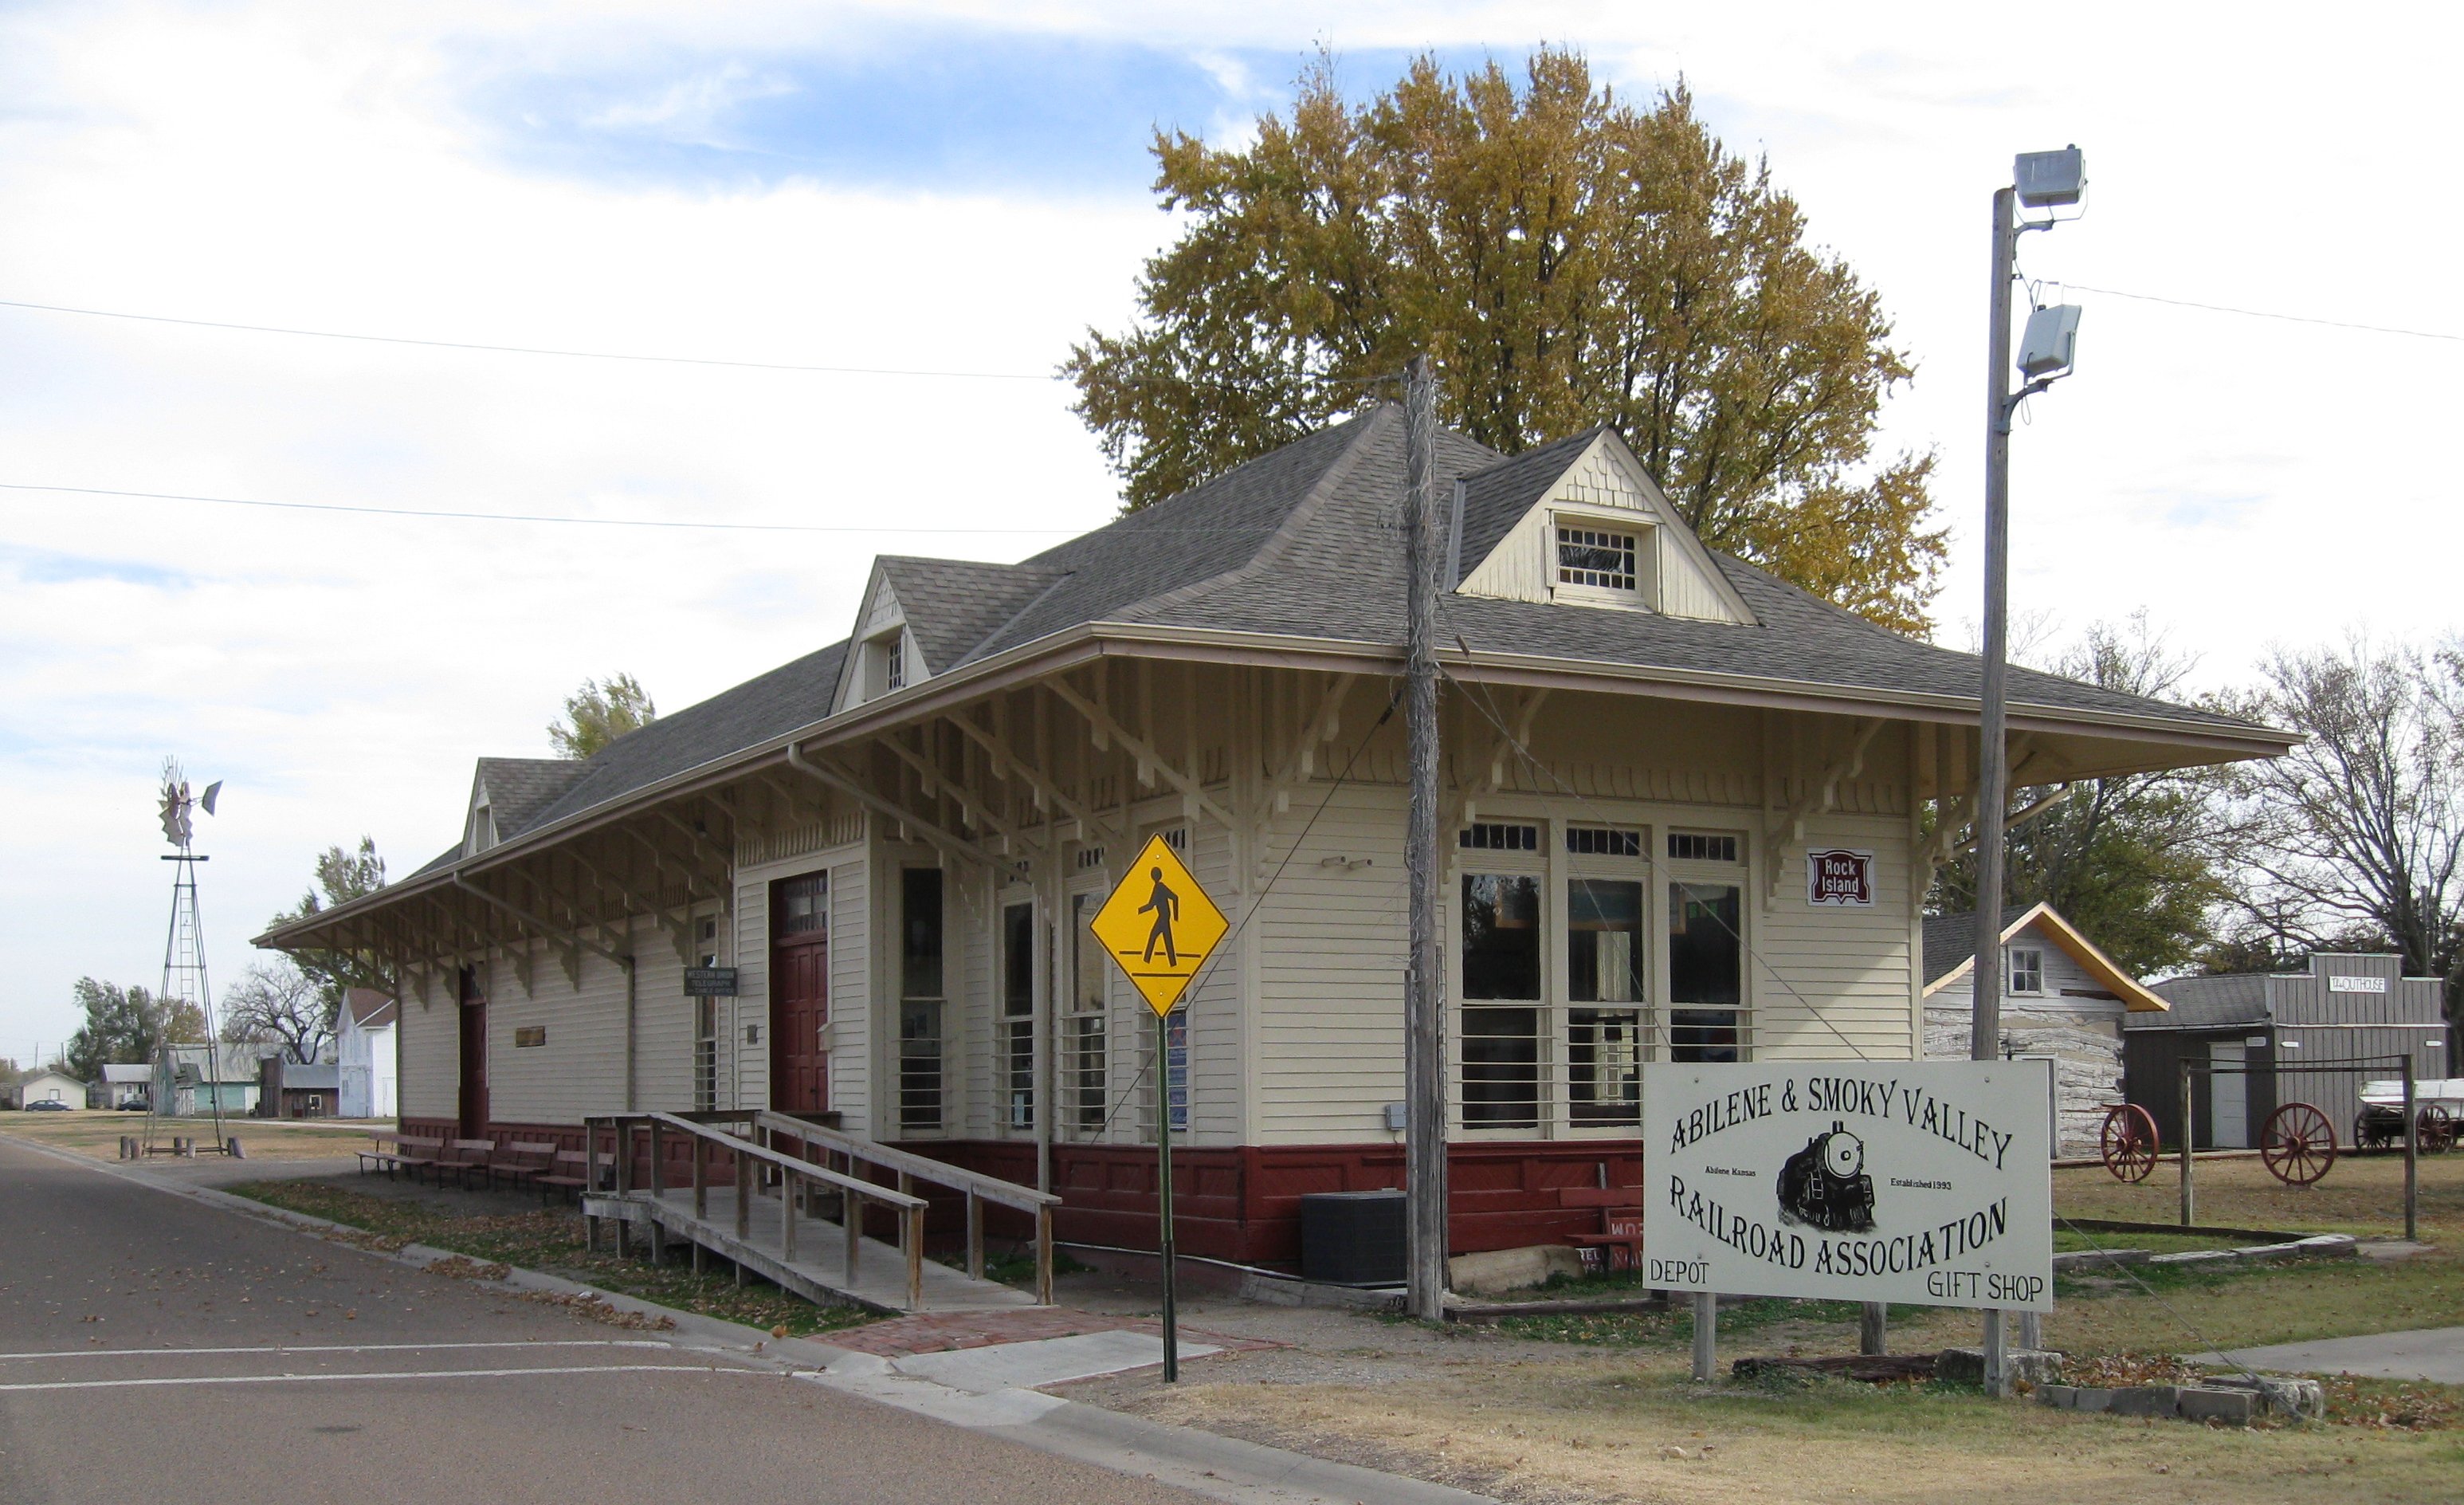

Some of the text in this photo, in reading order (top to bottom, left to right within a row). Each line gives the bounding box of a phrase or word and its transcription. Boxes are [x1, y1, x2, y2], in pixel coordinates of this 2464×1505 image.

[1825, 859, 1856, 875] Rock
[1822, 876, 1859, 893] Island
[2343, 977, 2384, 991] OUTHOUSE
[1669, 1077, 2013, 1171] ABILENE & SMOKY VALLEY
[1731, 1167, 1756, 1177] Kansas
[1889, 1177, 1952, 1190] Established 1993
[1669, 1174, 2007, 1277] RAILROAD ASSOCIATION
[1650, 1259, 1710, 1284] DEPOT
[1927, 1271, 2043, 1303] GIFT SHOP
